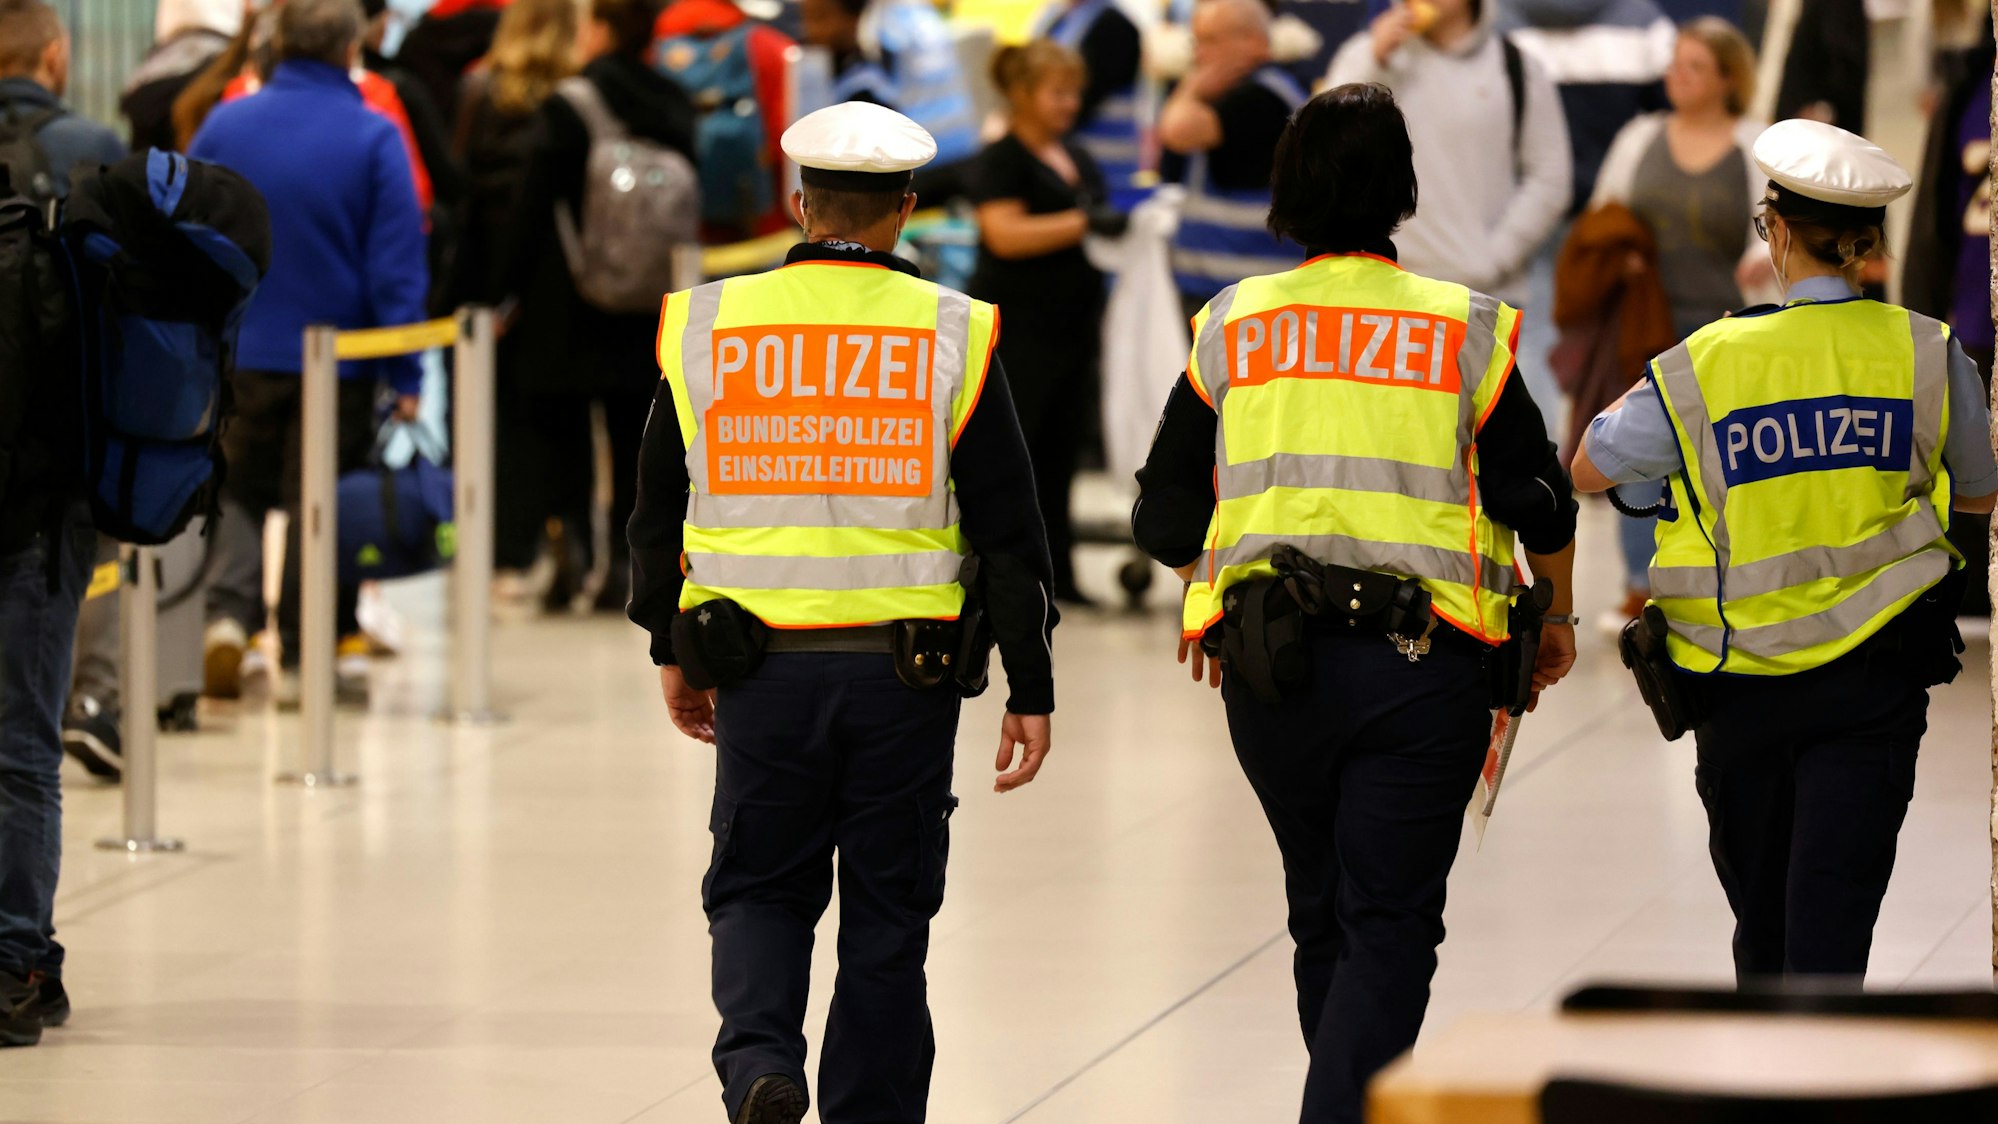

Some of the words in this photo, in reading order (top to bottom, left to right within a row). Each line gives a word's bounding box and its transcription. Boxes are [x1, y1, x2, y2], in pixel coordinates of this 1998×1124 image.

[714, 334, 929, 401] POLIZEI
[1236, 310, 1447, 385] POLIZEI
[1740, 352, 1903, 403] POLZEI
[717, 415, 923, 446] BUNDESPOLIZEI
[1727, 407, 1893, 471] POLIZEI
[718, 455, 921, 485] EINSATZLEITUNG
